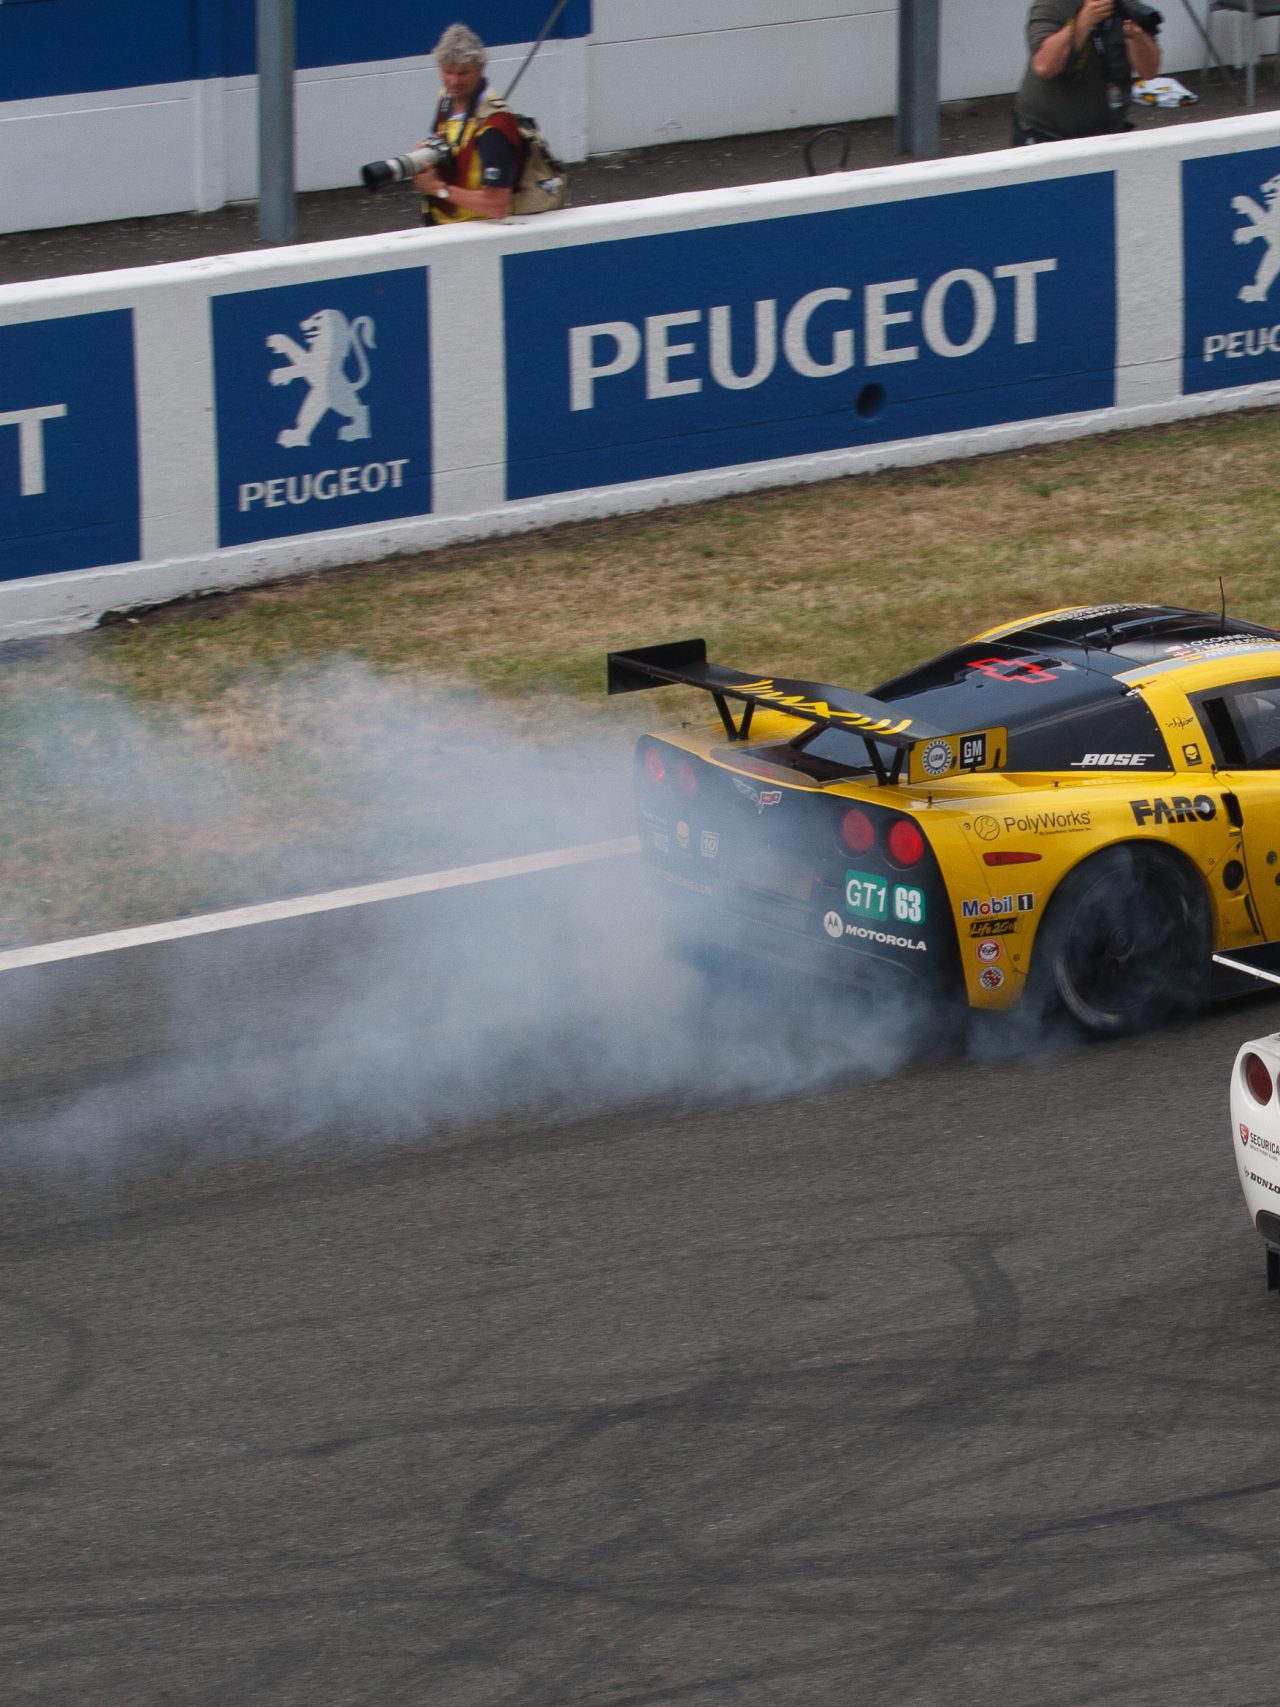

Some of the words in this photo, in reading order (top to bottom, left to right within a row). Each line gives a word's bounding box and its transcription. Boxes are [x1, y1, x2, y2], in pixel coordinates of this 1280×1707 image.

[568, 258, 1058, 412] PEUGEOT
[238, 459, 410, 512] PEUGEOT
[964, 740, 982, 758] GM
[1071, 754, 1154, 766] BOSE
[1004, 810, 1091, 833] PolyWorks
[1129, 794, 1217, 826] FARO
[846, 879, 886, 913] GT1
[895, 887, 922, 922] 63
[962, 895, 1013, 917] Mobil
[845, 924, 927, 951] MOTOROLA
